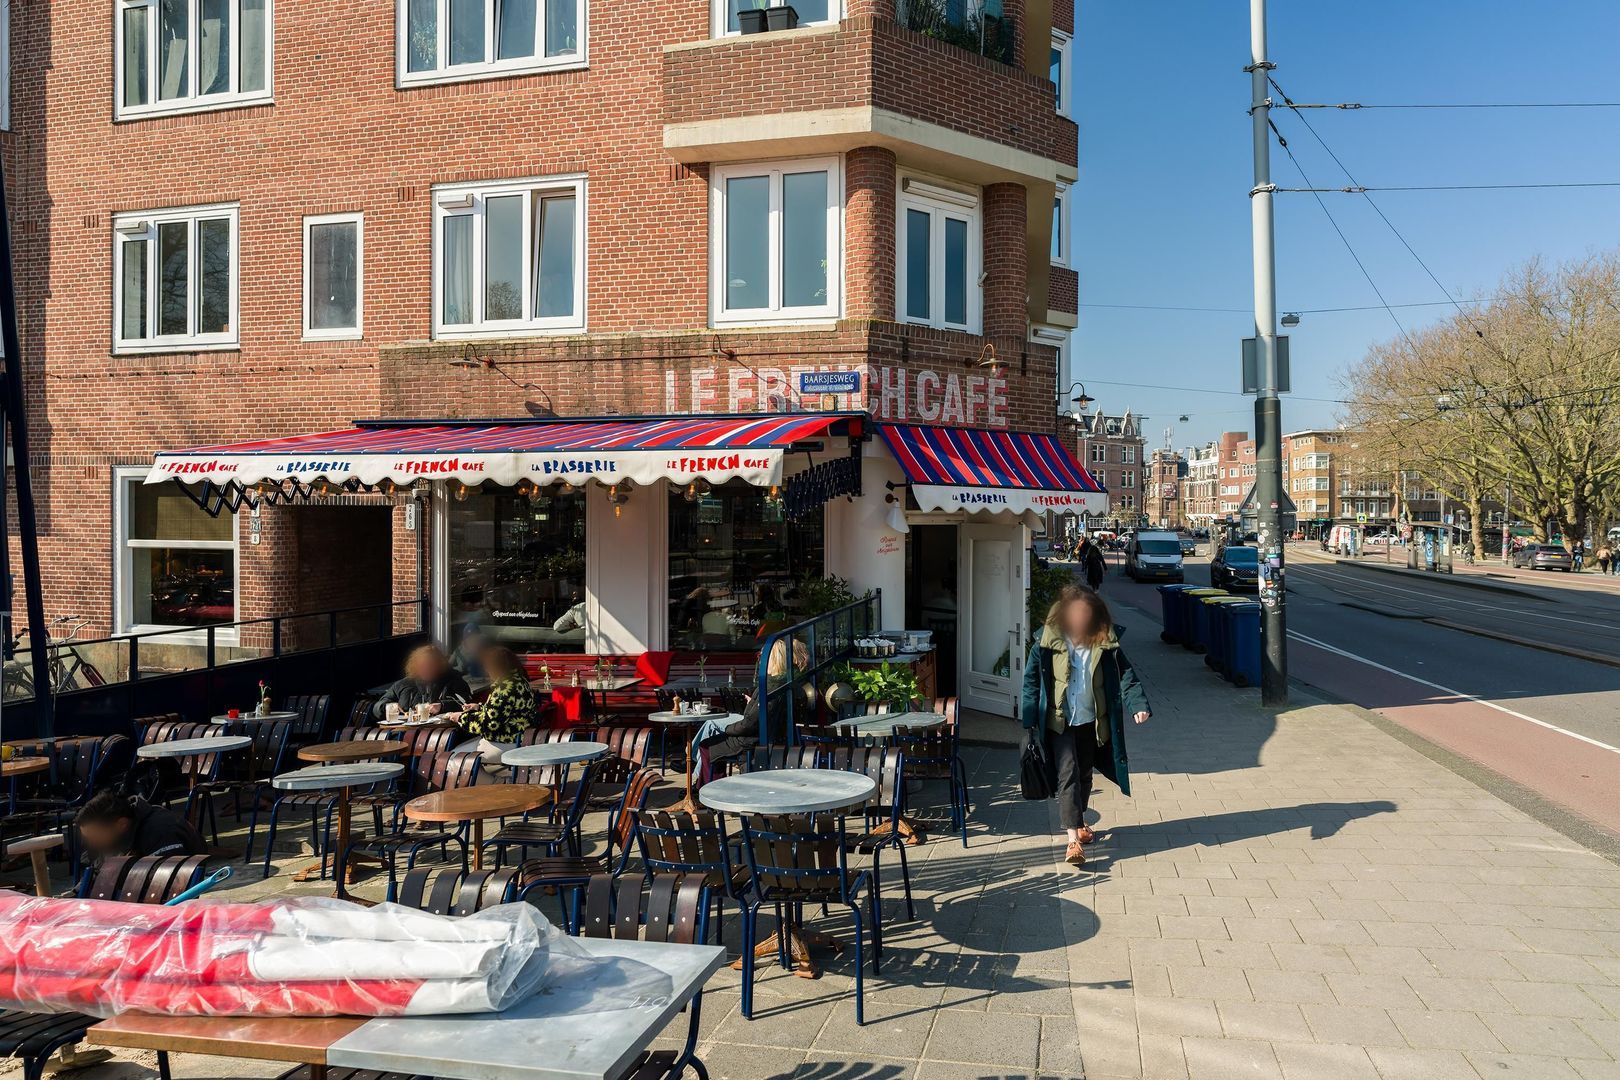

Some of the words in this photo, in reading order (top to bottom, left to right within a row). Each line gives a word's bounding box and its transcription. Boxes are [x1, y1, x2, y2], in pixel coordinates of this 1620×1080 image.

[804, 374, 855, 385] BAARSJESWEG
[167, 460, 218, 473] FRENCH
[218, 463, 240, 472] CAFÉ
[286, 461, 351, 473] BRASSERIE
[394, 463, 404, 471] LE
[405, 458, 459, 474] FRENCH
[461, 461, 485, 471] CAFÉ
[543, 460, 617, 474] BRASSERIE
[666, 460, 677, 469] LE
[680, 453, 740, 473] FRENCH
[743, 458, 769, 469] CAFÉ
[959, 492, 1008, 504] BRASSERIE
[1039, 494, 1072, 506] FRENCH
